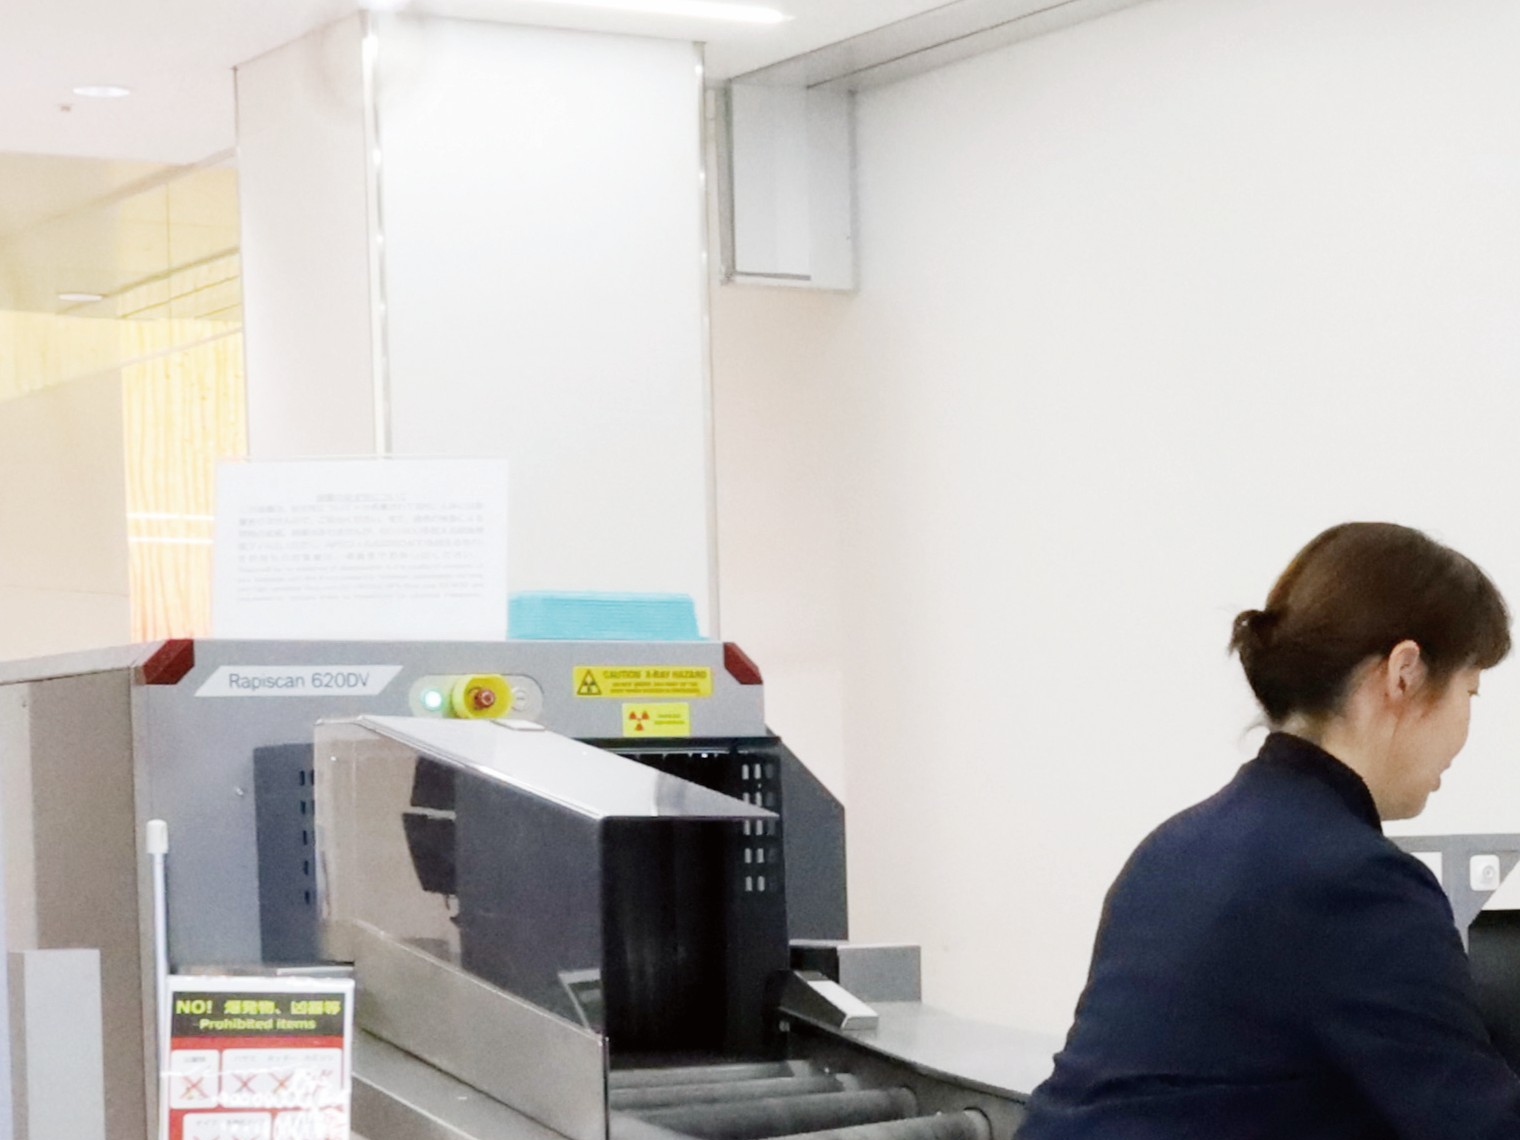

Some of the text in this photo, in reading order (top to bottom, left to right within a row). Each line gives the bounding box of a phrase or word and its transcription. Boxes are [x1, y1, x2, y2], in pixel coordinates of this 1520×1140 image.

[229, 672, 370, 691] Rapiscan 620DV
[176, 1000, 213, 1015] NO!
[199, 1018, 274, 1030] Prohibited
